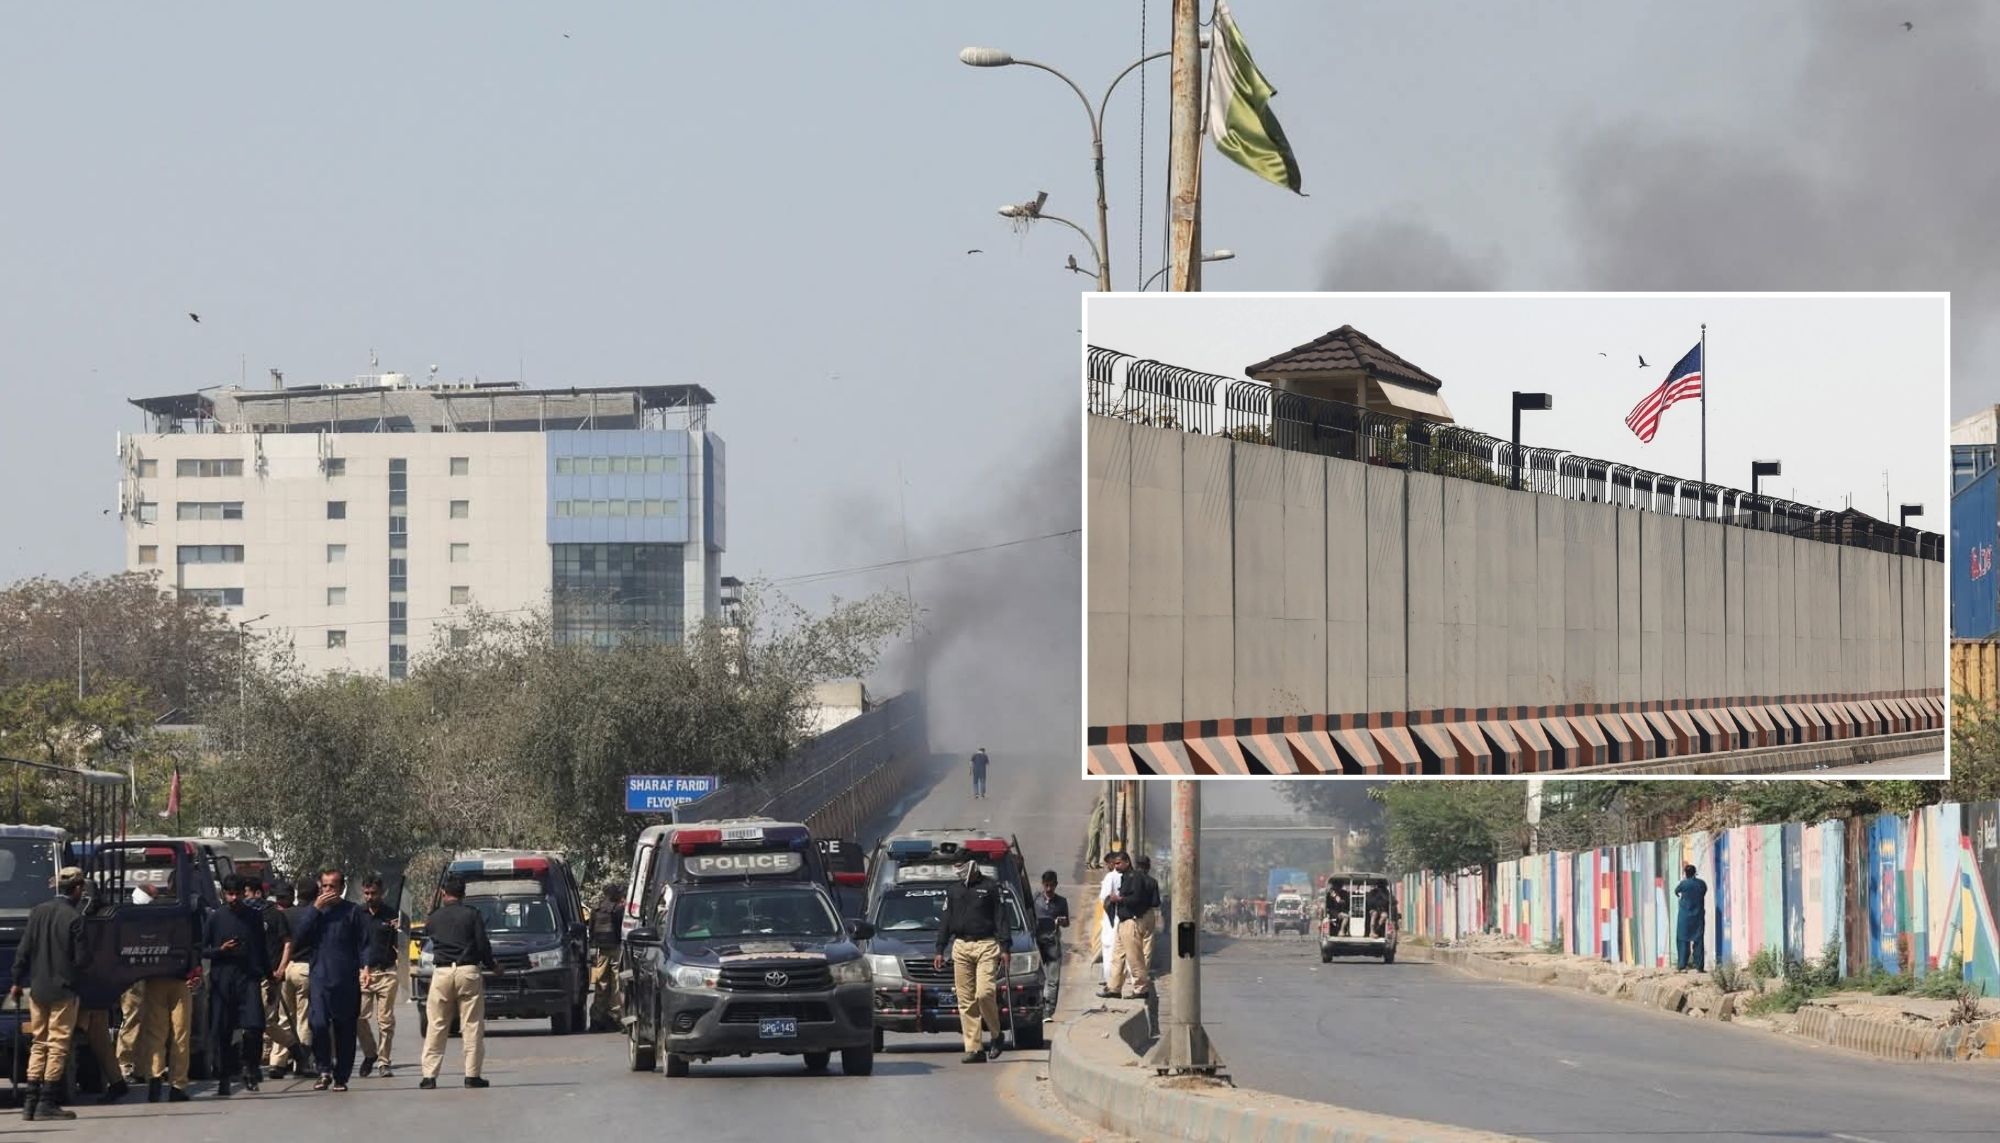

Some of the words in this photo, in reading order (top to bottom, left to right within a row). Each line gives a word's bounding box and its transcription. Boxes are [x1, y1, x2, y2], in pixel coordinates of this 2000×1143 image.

[630, 780, 673, 791] SHARAF
[676, 780, 709, 791] FARIDI
[701, 855, 788, 870] POLICE
[121, 946, 168, 955] MASTER
